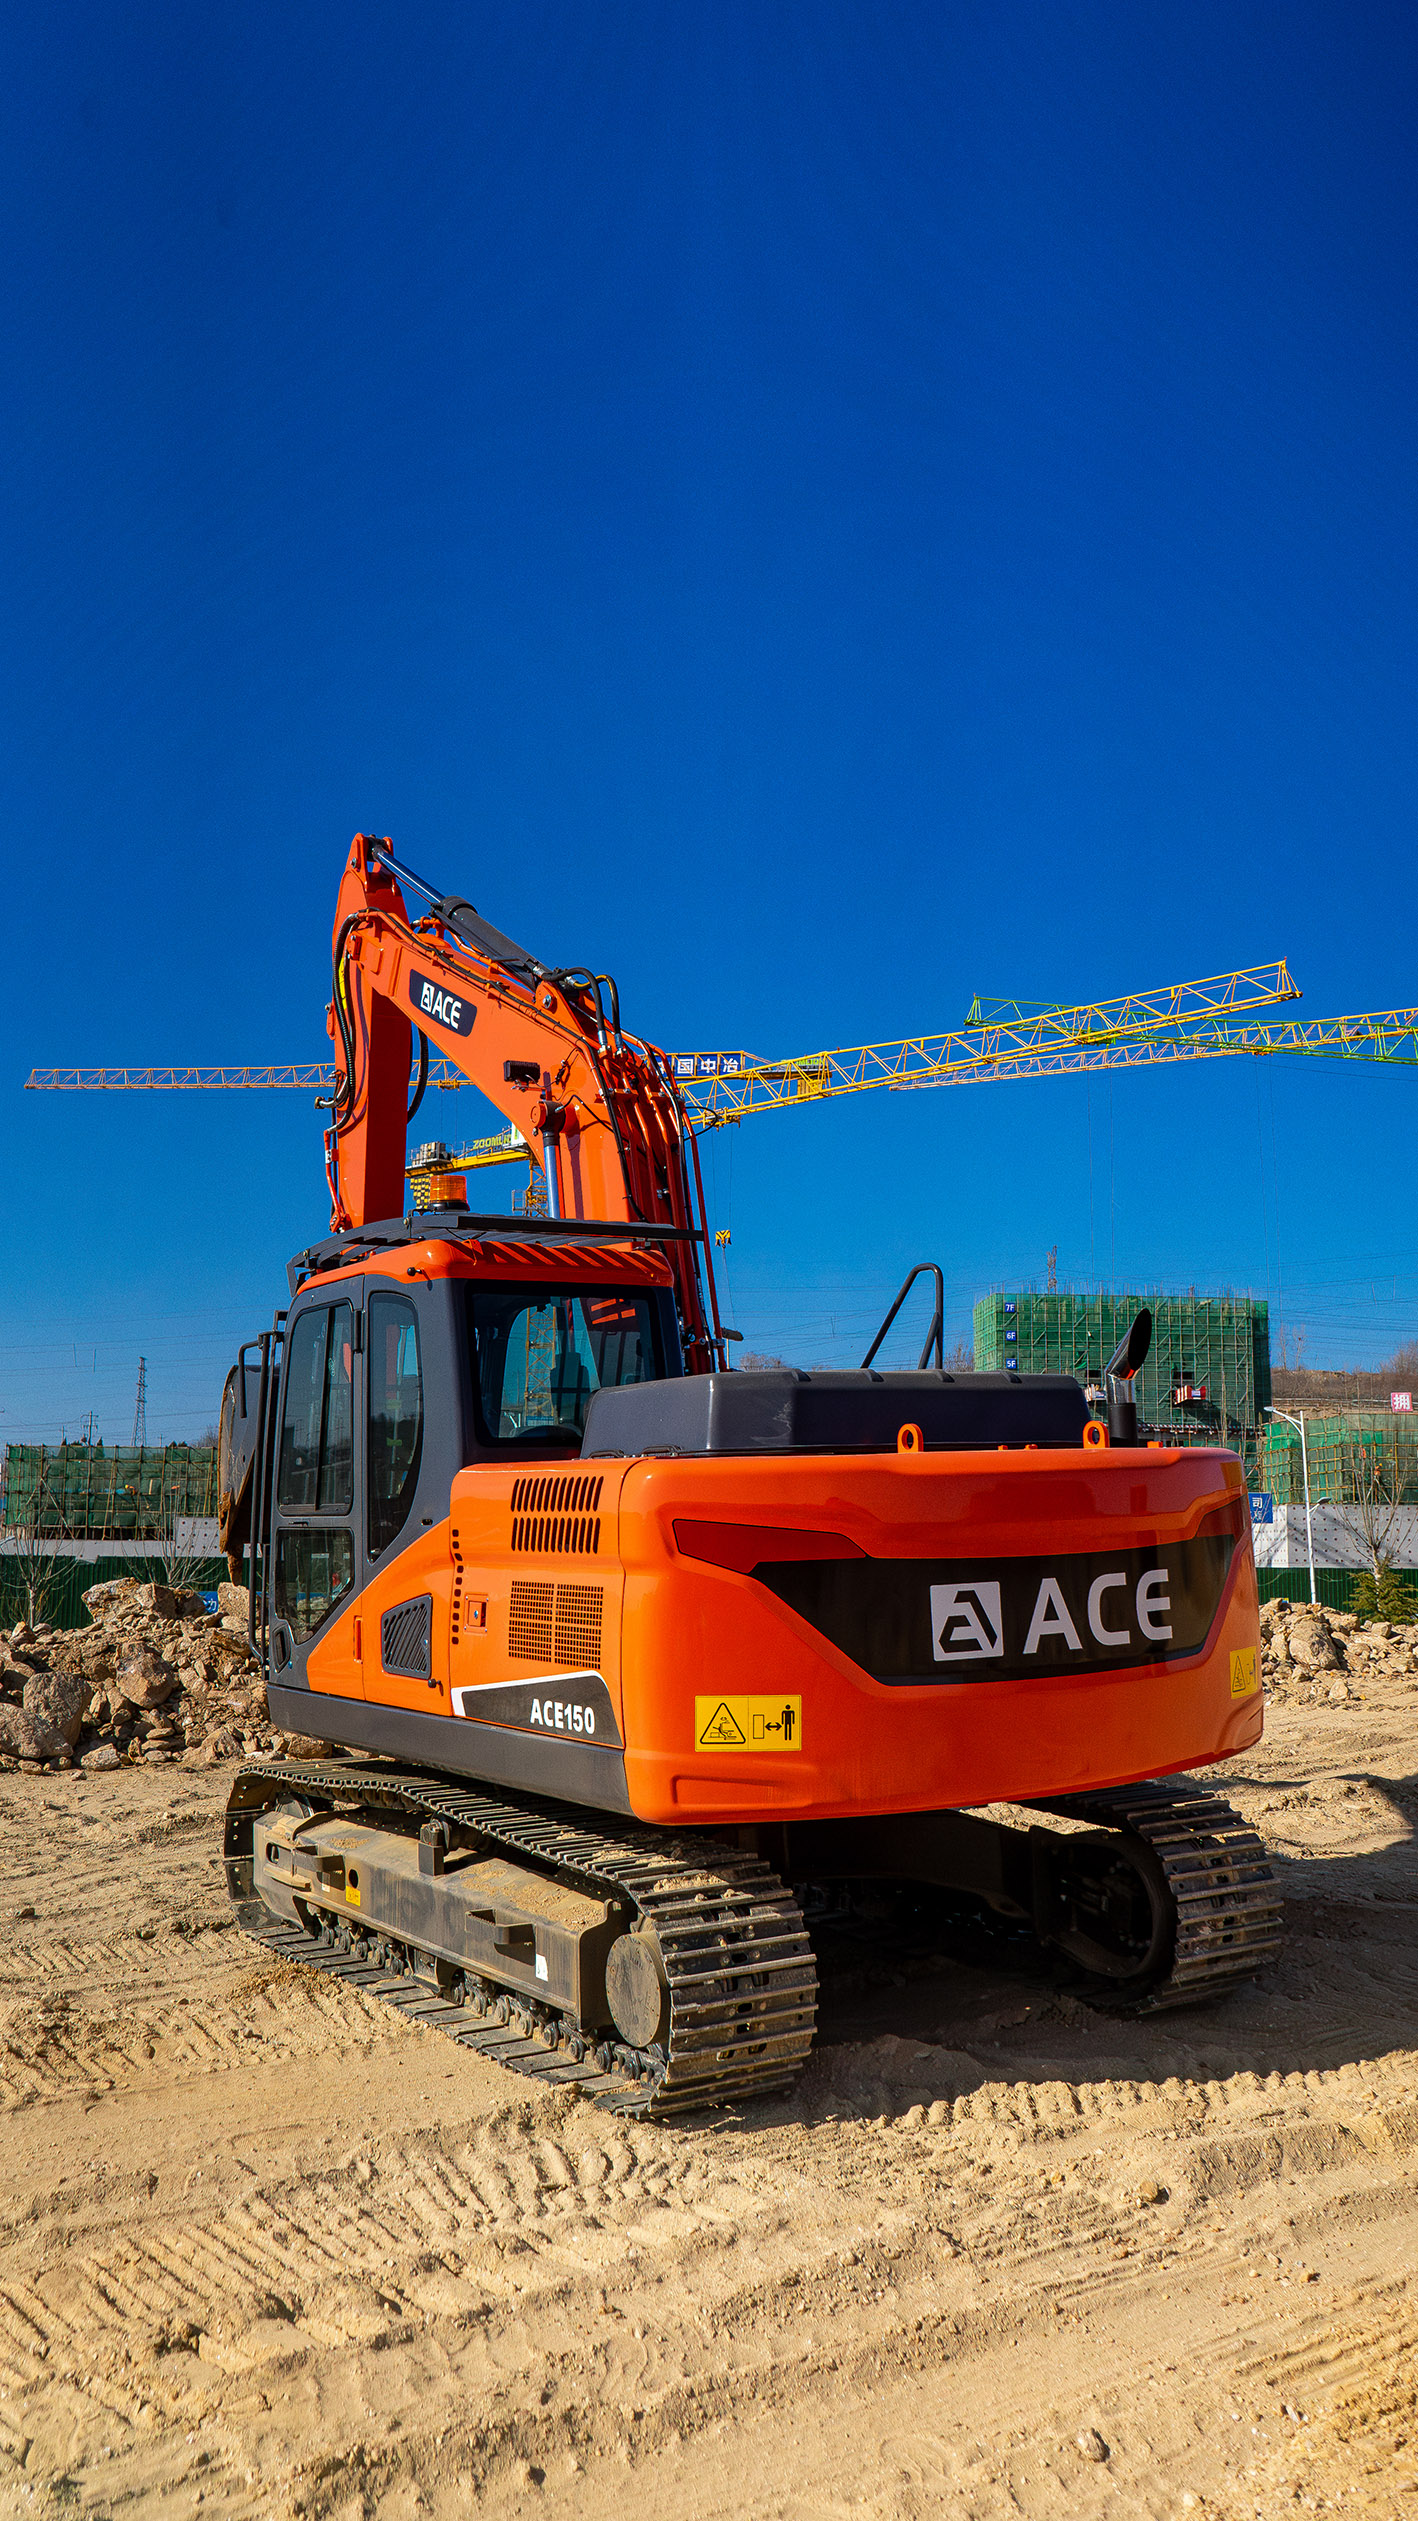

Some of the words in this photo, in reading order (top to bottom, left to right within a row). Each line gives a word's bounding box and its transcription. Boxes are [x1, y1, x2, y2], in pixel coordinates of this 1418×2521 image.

[432, 991, 462, 1030] ACE
[472, 1134, 512, 1150] ZOOMLIO
[1005, 1303, 1015, 1312] 7F
[1006, 1332, 1016, 1340] 6F
[1006, 1360, 1016, 1368] 5F
[1393, 1394, 1411, 1410] 拥
[1251, 1497, 1263, 1509] 司
[1022, 1568, 1174, 1655] ACE
[529, 1697, 596, 1735] ACE150
